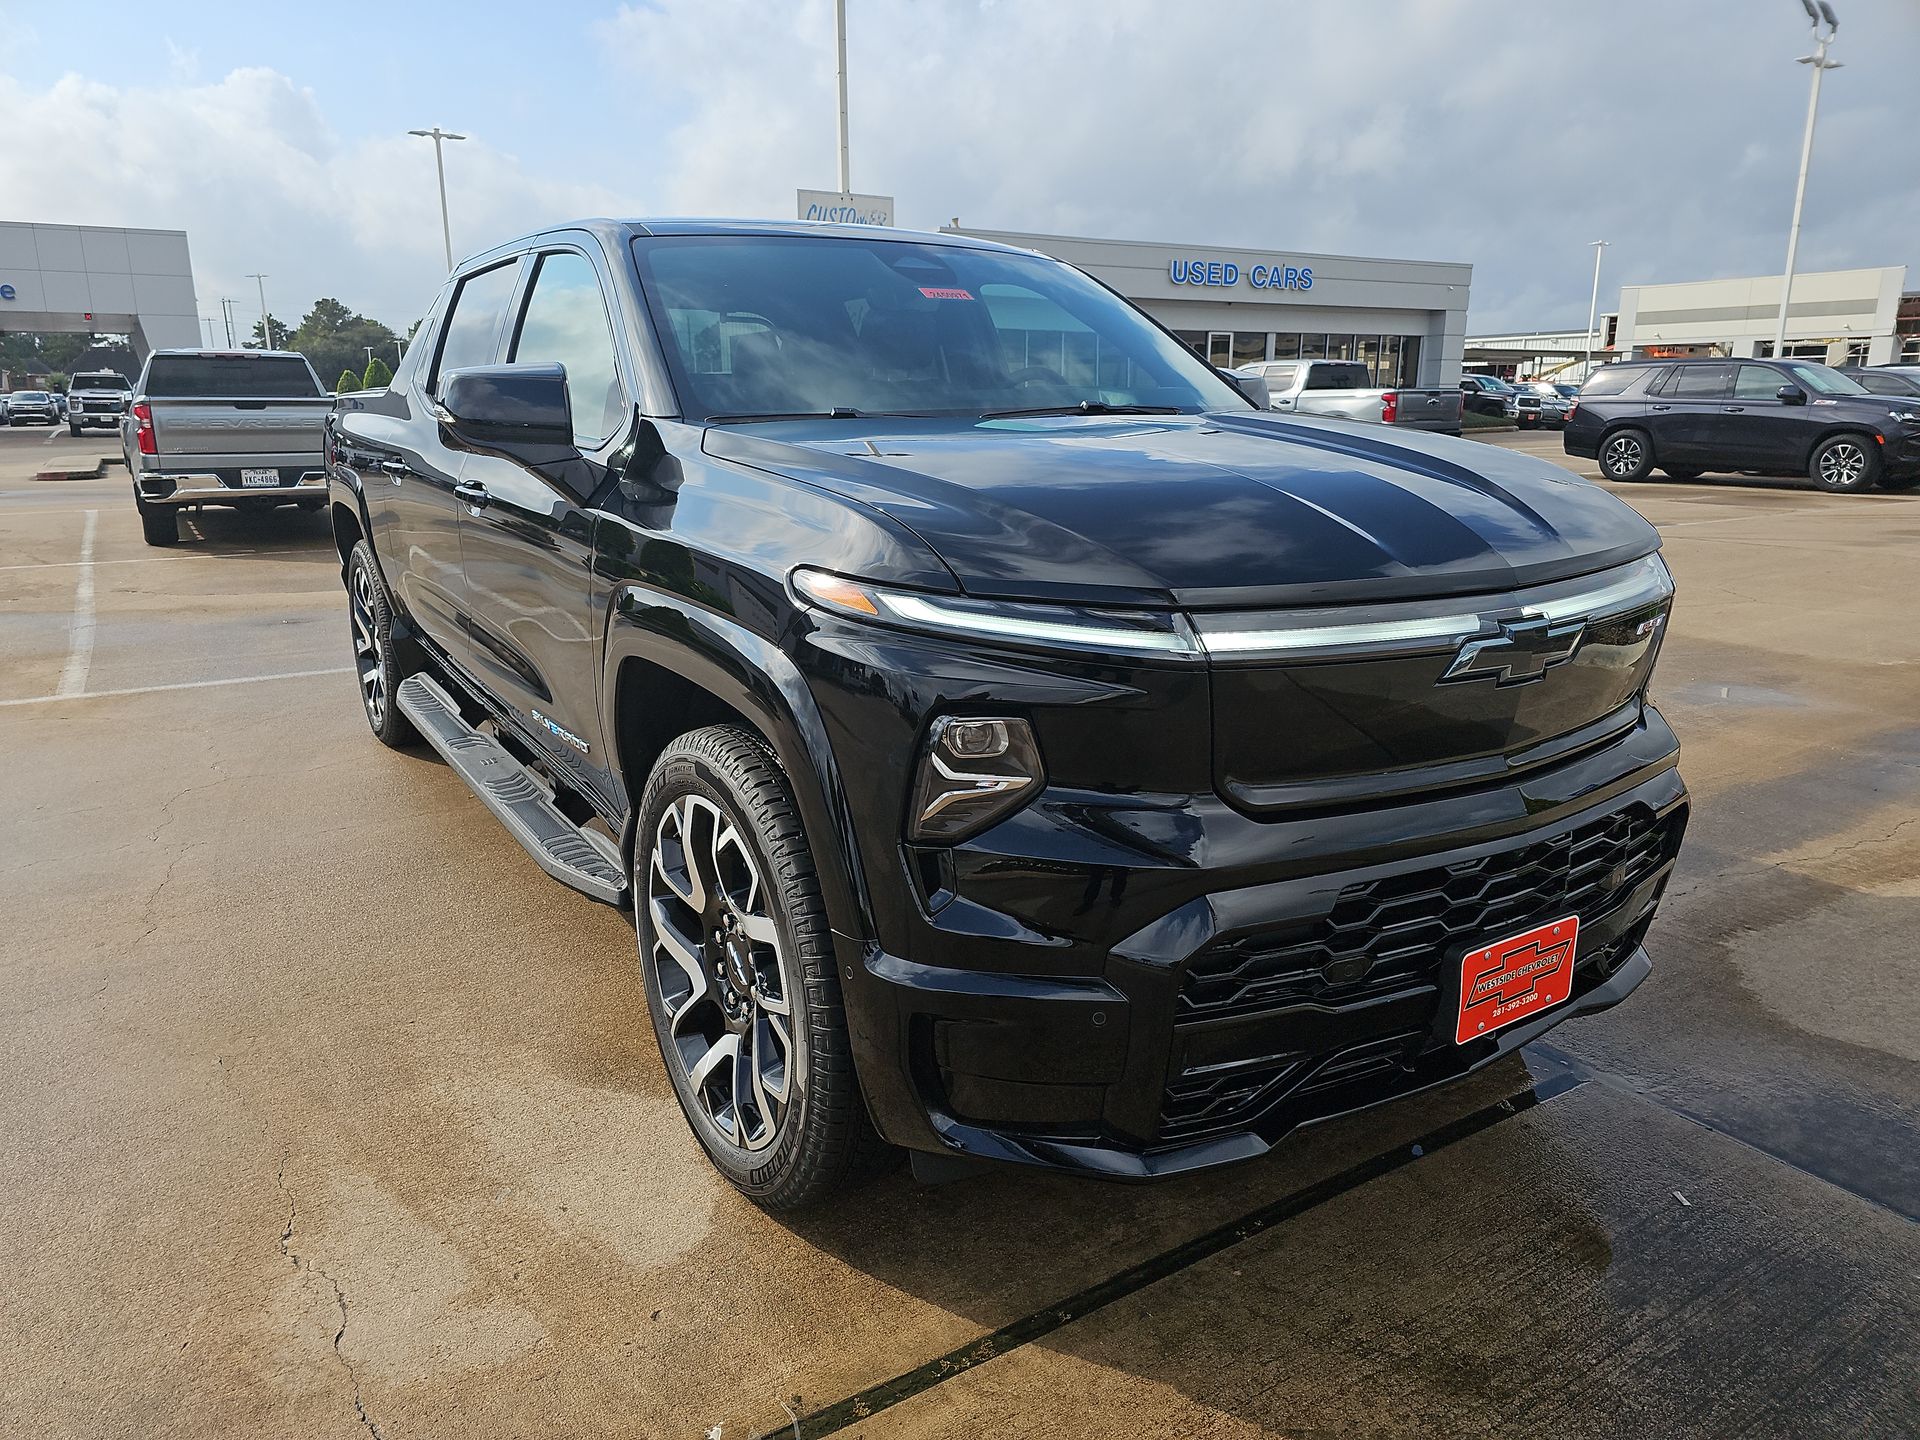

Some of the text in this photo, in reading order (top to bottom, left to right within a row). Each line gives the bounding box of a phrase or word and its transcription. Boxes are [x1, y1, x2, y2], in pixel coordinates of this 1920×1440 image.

[1171, 260, 1313, 290] USED CARS
[1477, 953, 1559, 993] WESTSIDE CHEVROLET
[1492, 993, 1539, 1018] 281-392-3200
